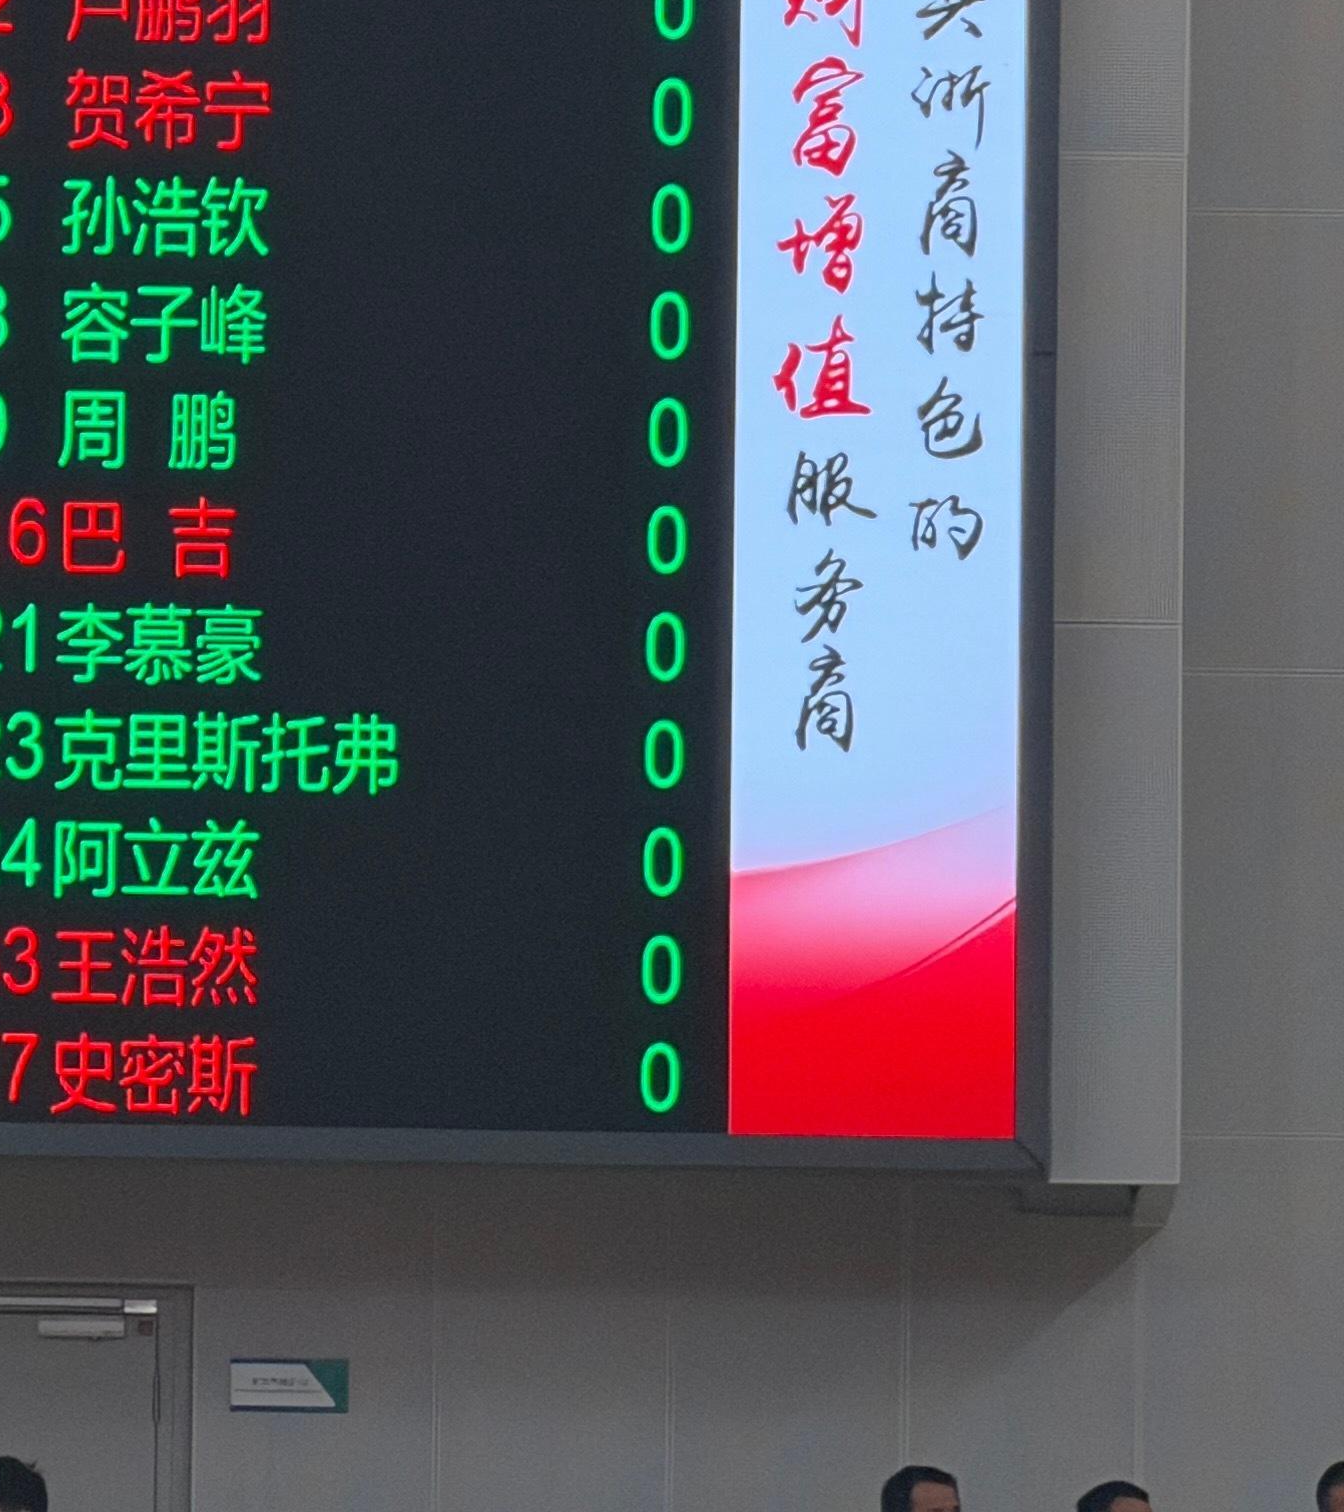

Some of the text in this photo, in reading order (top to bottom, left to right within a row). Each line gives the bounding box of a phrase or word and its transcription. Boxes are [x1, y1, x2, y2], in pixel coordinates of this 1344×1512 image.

[64, 66, 274, 153] 贺希宁
[651, 76, 694, 148] 0
[60, 174, 270, 259] 孙浩钦
[650, 182, 693, 255] 0
[59, 280, 269, 366] 容子峰
[648, 289, 691, 362] 0
[647, 396, 690, 469] 0
[645, 504, 688, 576] 0
[54, 601, 264, 687] 李慕豪
[644, 610, 687, 684] 0
[53, 707, 400, 797] 克里斯托弗
[643, 718, 686, 791] 0
[52, 815, 262, 900] 阿立兹
[642, 825, 684, 899] 0
[49, 923, 258, 1009] 王浩然
[640, 933, 683, 1006] 0
[48, 1030, 259, 1118] 史密斯
[639, 1040, 682, 1114] 0
